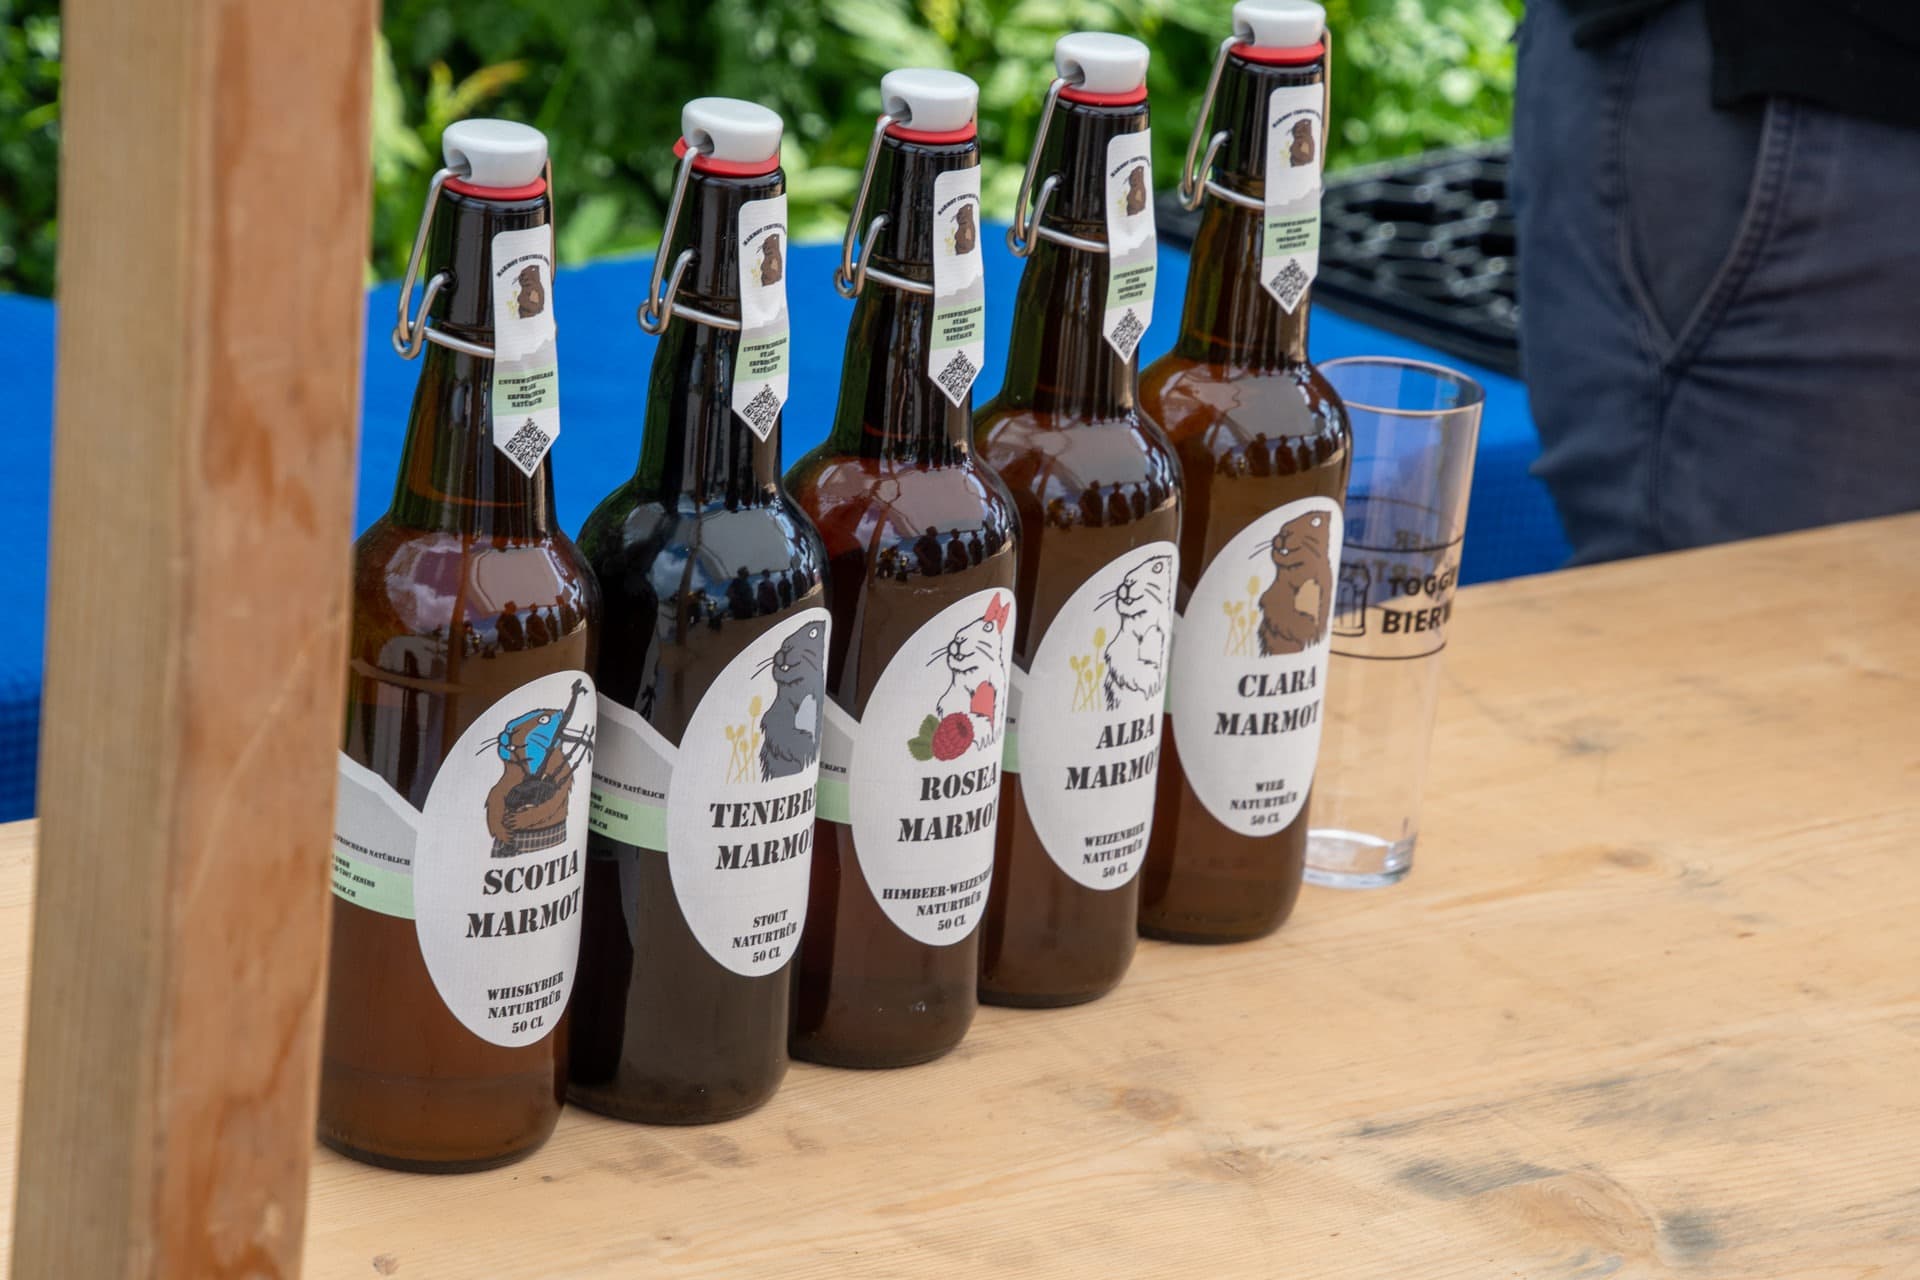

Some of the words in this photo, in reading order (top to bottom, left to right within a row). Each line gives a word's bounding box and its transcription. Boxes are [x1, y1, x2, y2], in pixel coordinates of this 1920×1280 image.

[1238, 665, 1316, 698] CLARA
[1096, 714, 1154, 749] ALBA
[1214, 699, 1320, 736] MARMOT
[920, 761, 997, 801] ROSEA
[1084, 821, 1145, 847] WEIZENBIER
[369, 848, 411, 867] NATÜRLICH
[482, 849, 578, 895] SCOTIA
[1102, 866, 1115, 878] 50
[465, 886, 581, 939] MARMOT
[752, 909, 788, 929] STOUT
[937, 919, 952, 931] 50
[954, 914, 966, 927] CL
[731, 922, 797, 949] NATURTRÜB
[752, 951, 766, 963] 50
[768, 946, 781, 960] CL
[487, 971, 564, 1001] WHISKYBIER
[488, 990, 561, 1019] NATURTRÜB
[512, 1021, 528, 1034] 50
[530, 1015, 544, 1030] CL
